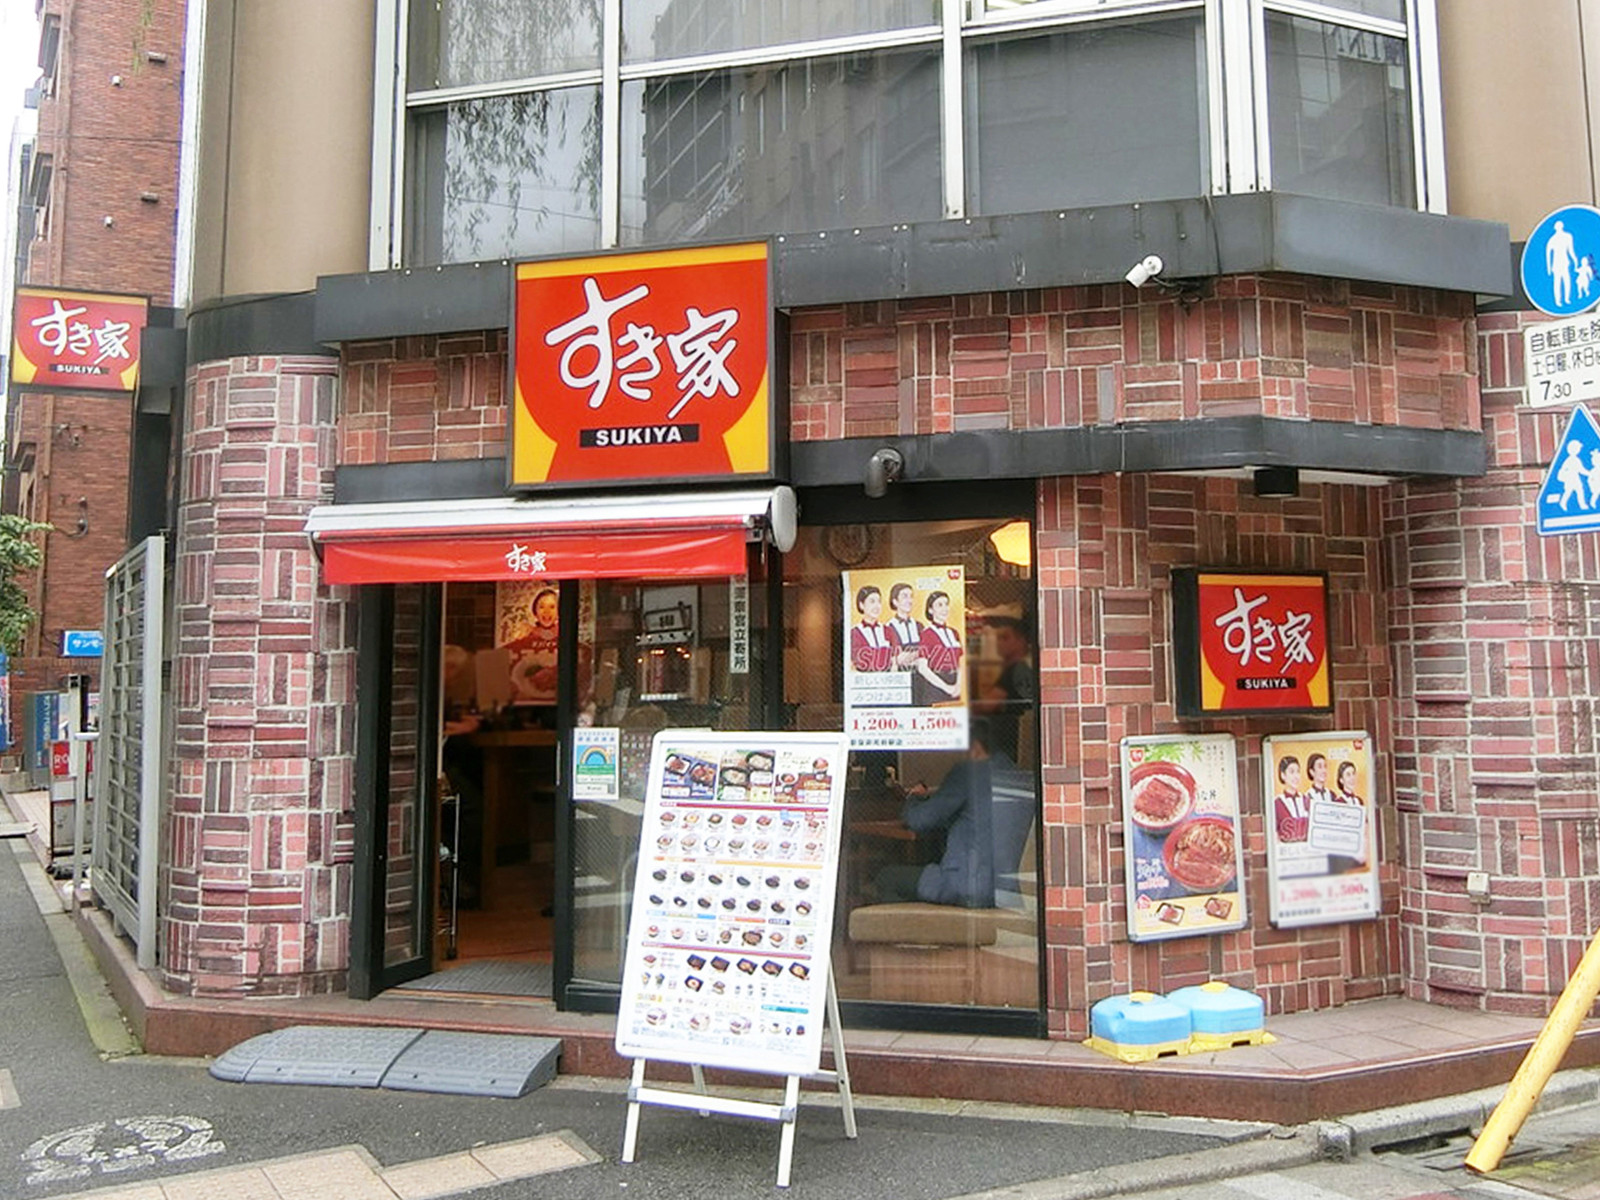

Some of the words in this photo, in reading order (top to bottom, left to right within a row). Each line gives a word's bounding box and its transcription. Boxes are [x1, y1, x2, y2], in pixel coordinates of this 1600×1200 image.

[31, 299, 130, 365] すき家
[545, 277, 740, 419] すき家
[56, 364, 101, 374] SUKIYA
[596, 426, 682, 446] SUKIYA
[505, 543, 547, 575] すき家
[1215, 588, 1315, 674] すき家
[1244, 678, 1289, 689] SUKIYA
